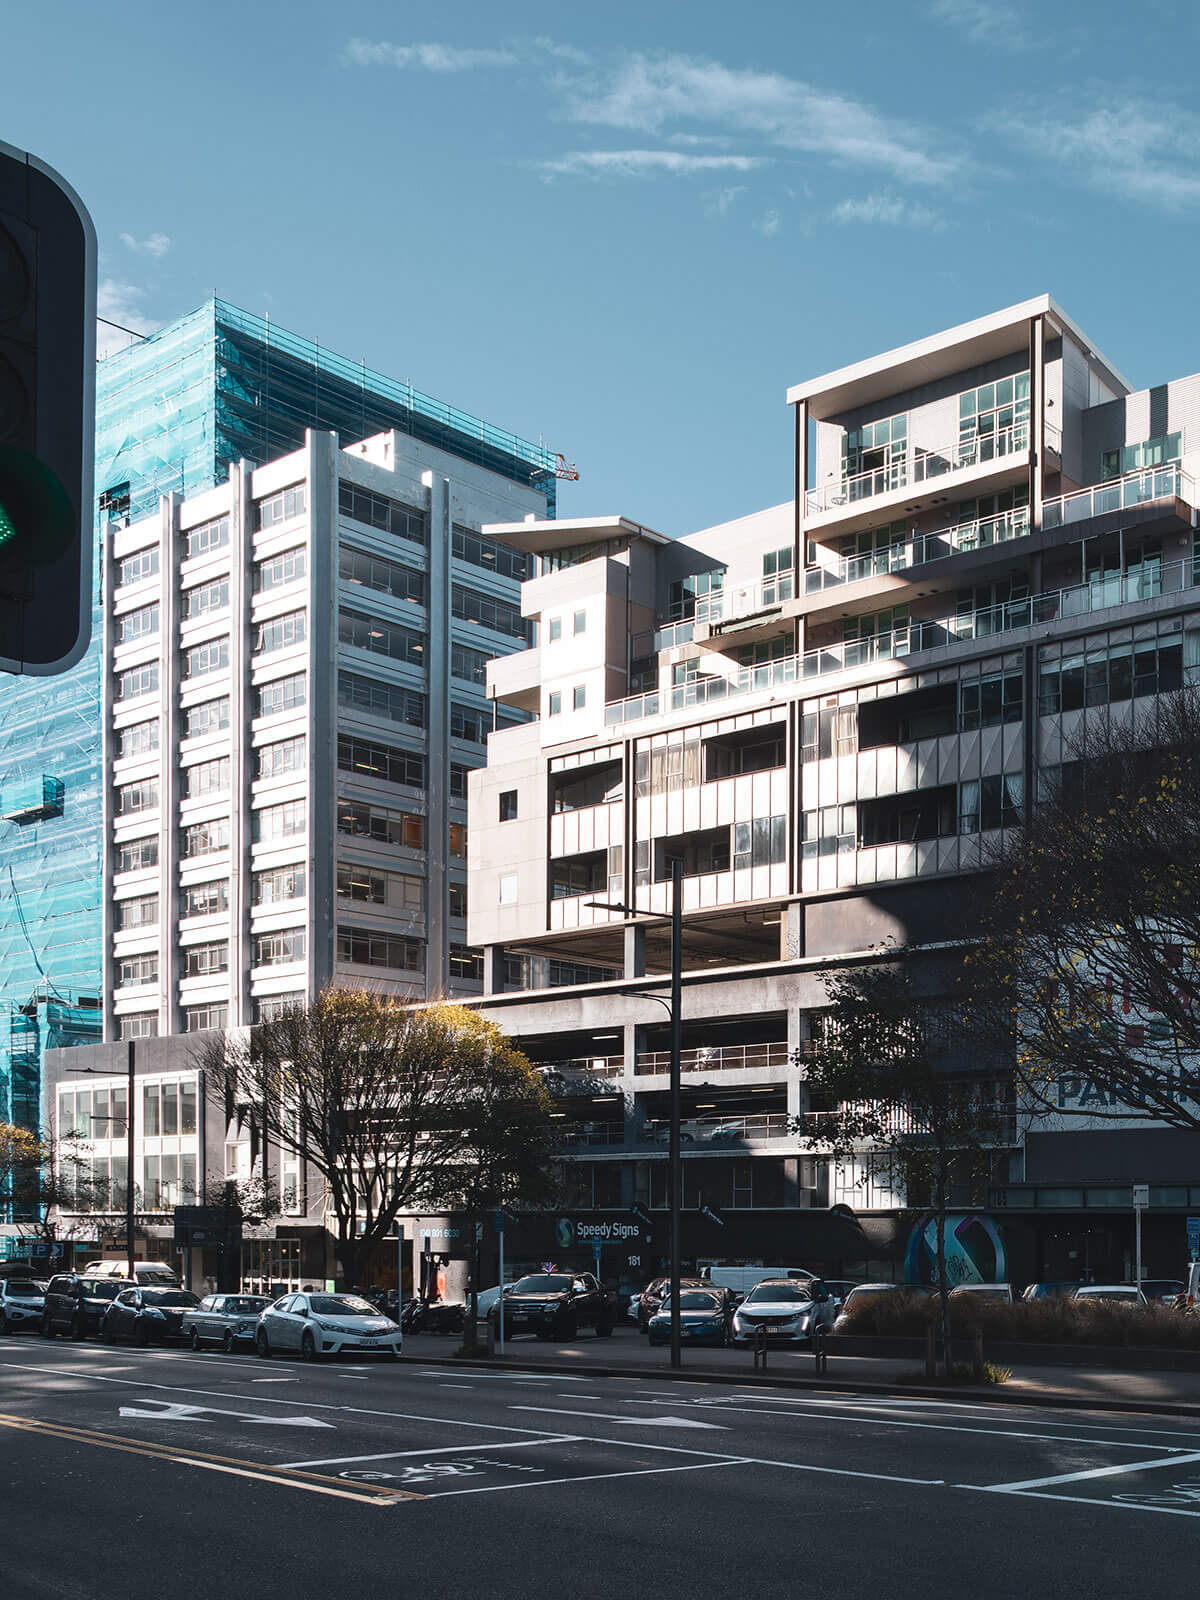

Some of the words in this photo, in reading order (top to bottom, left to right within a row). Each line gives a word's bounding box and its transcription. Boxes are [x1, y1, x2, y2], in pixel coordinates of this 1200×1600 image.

[577, 1222, 612, 1239] Speedy
[612, 1222, 640, 1239] Signs
[37, 1245, 46, 1255] P
[628, 1256, 641, 1266] 181
